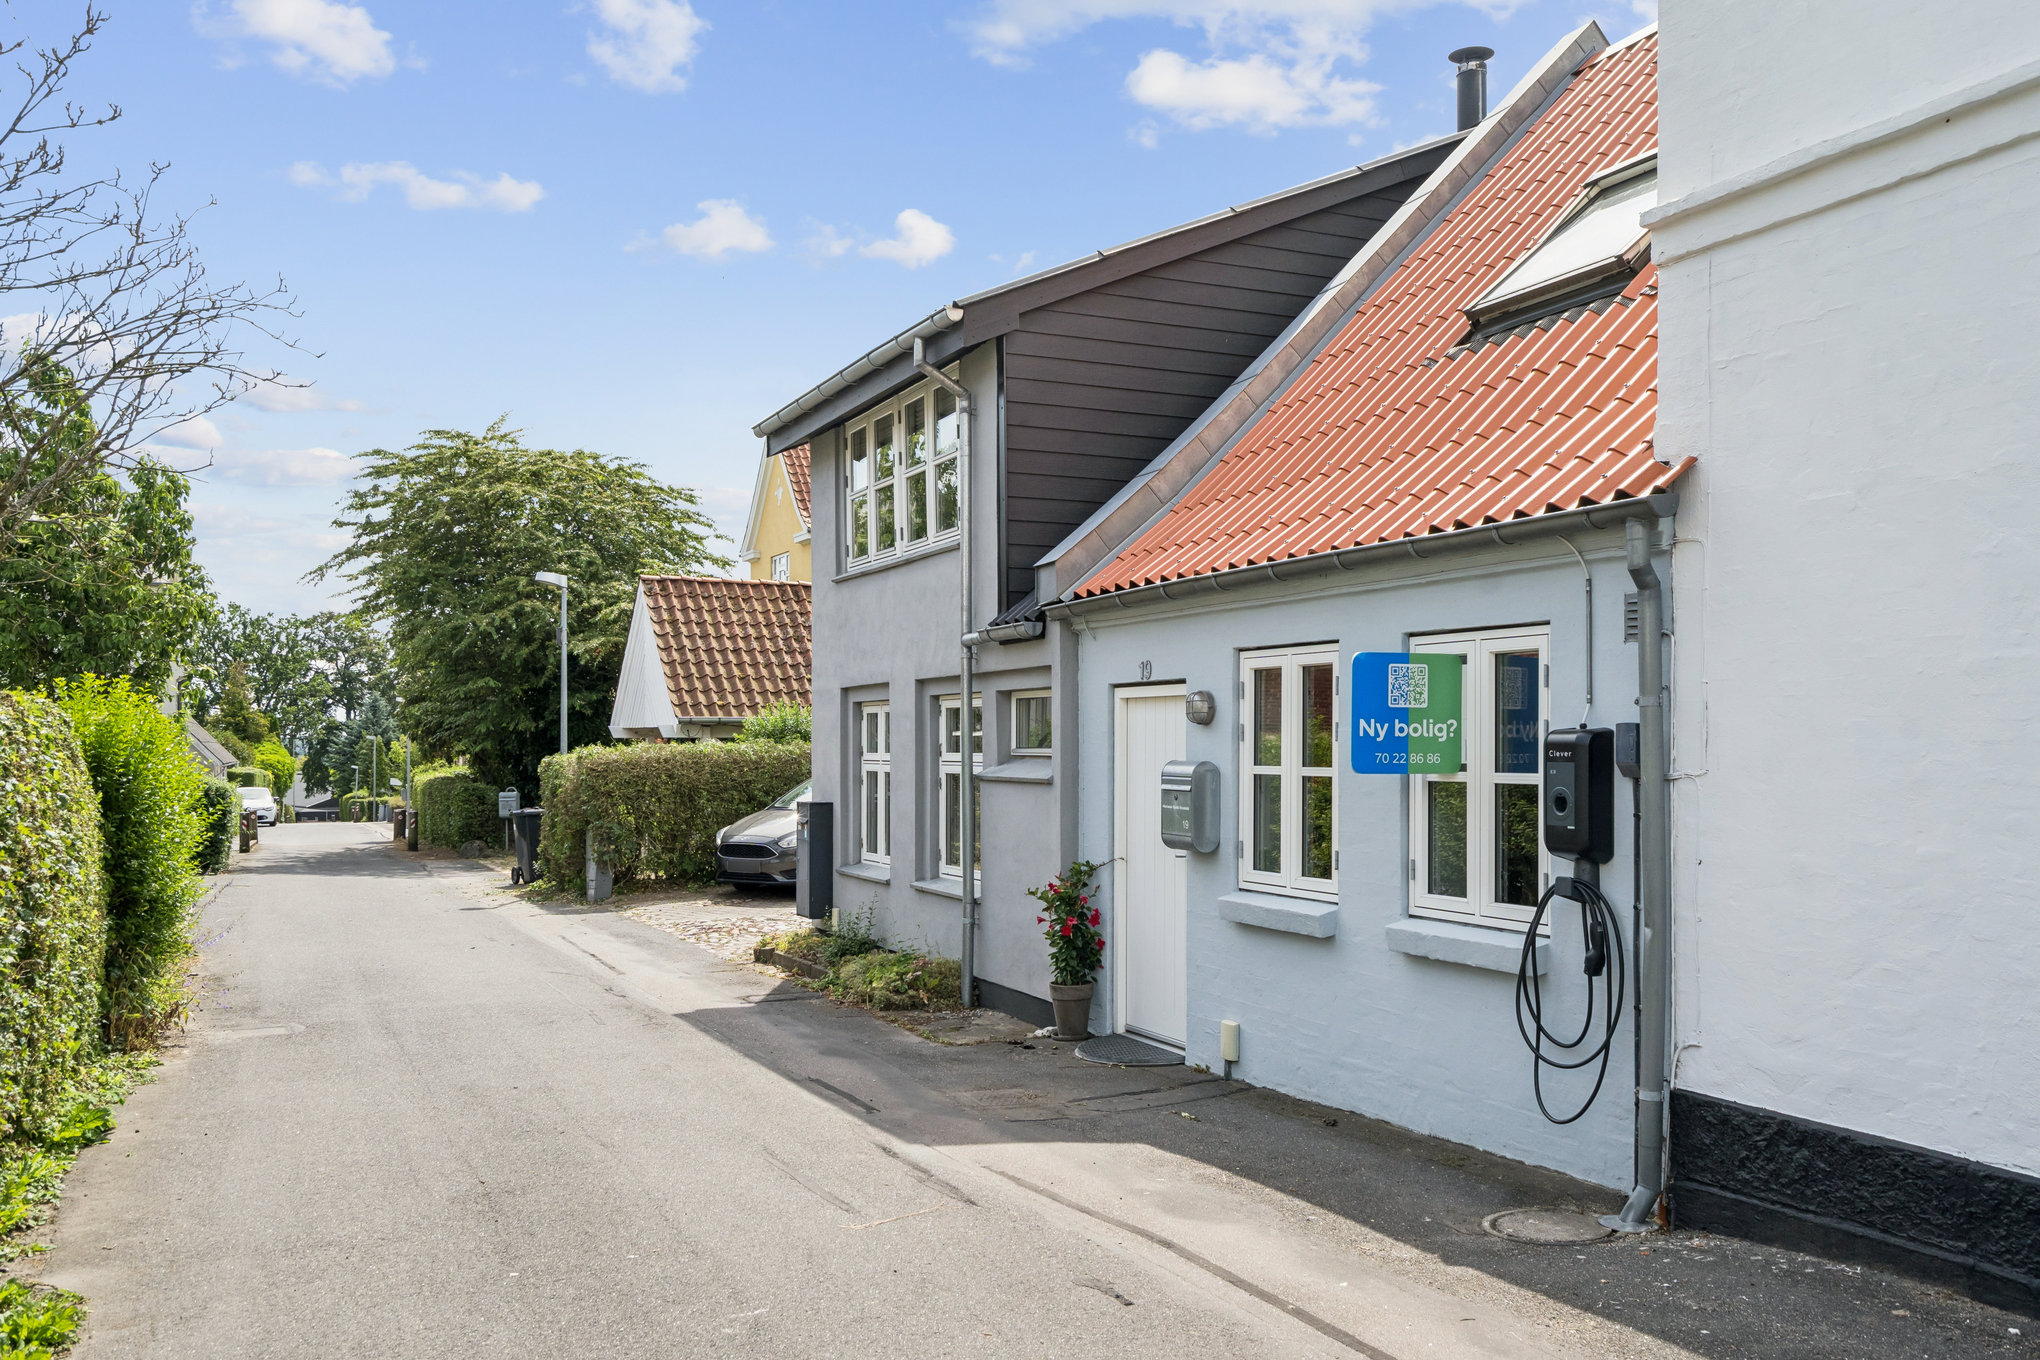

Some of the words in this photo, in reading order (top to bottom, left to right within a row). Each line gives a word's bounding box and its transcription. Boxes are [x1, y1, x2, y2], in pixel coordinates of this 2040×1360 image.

[1139, 659, 1152, 681] 19
[1359, 718, 1389, 742] Ny
[1394, 718, 1458, 742] bolig?
[1375, 753, 1390, 764] 70
[1392, 753, 1407, 764] 22
[1409, 753, 1424, 764] 86
[1426, 753, 1441, 764] 86
[1548, 750, 1572, 758] Clever
[1182, 819, 1190, 830] 19
